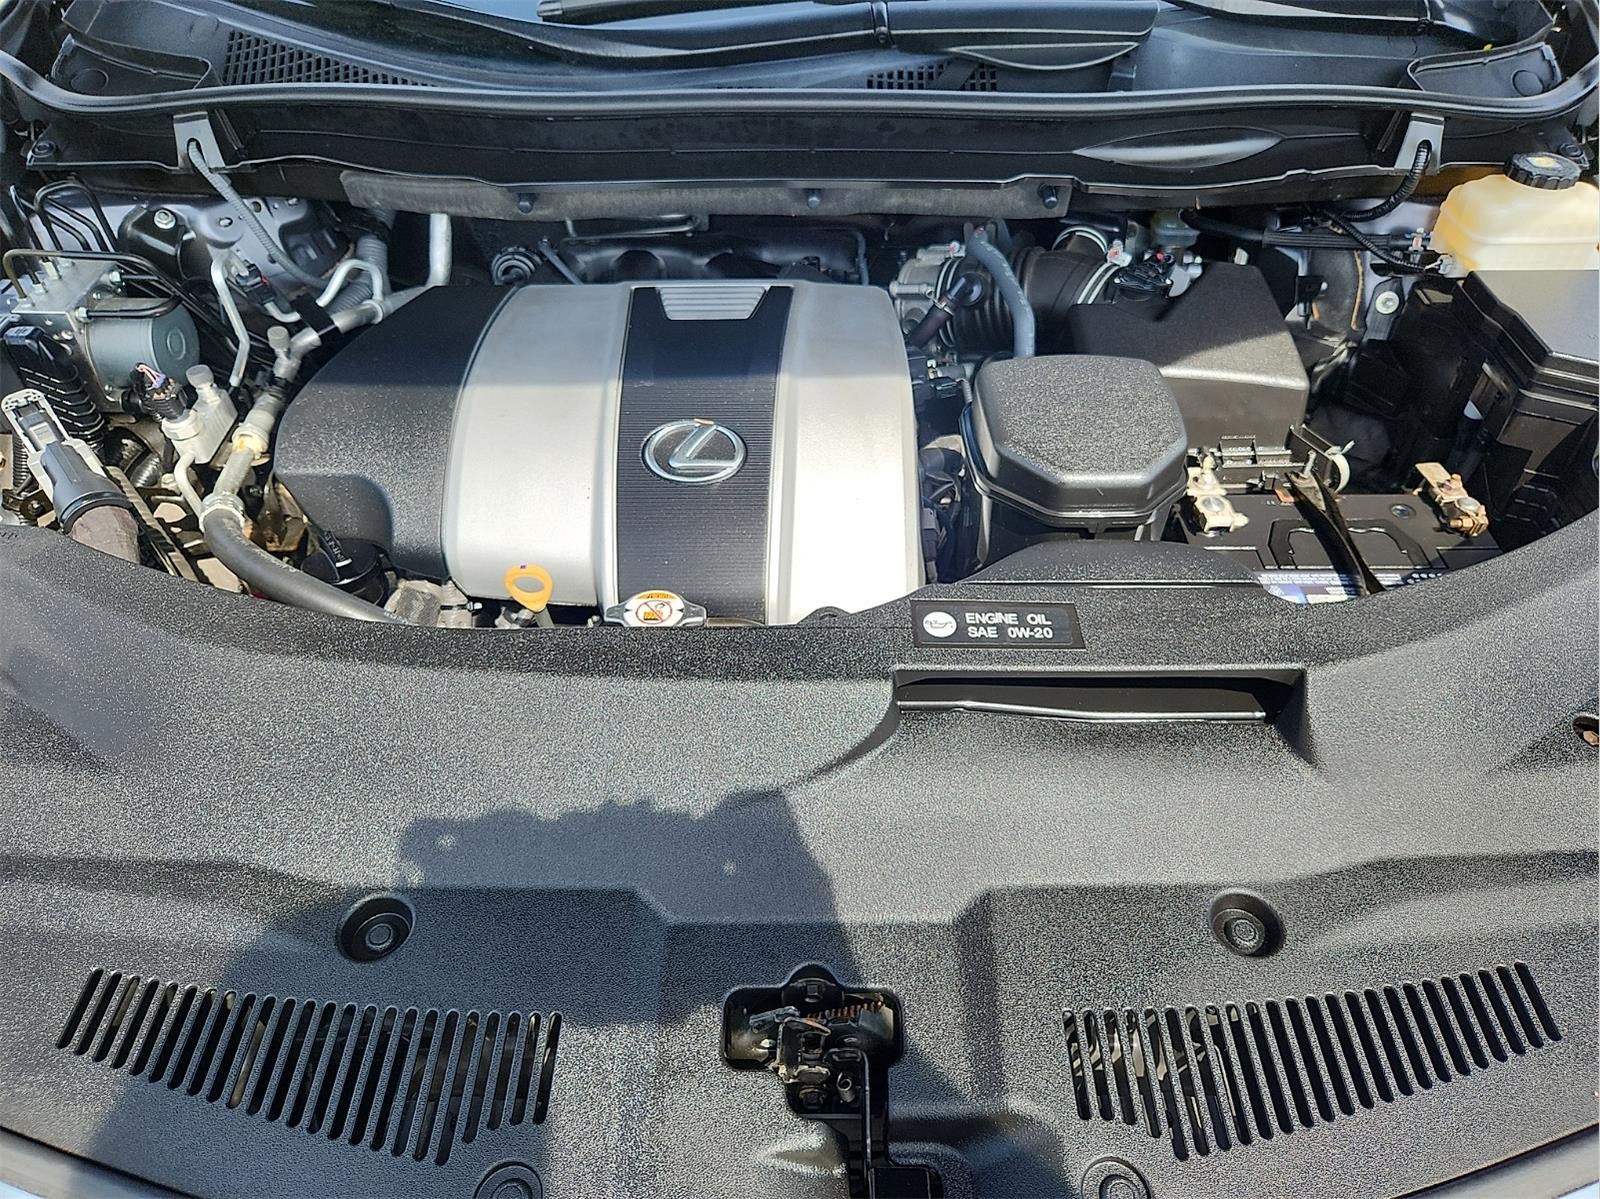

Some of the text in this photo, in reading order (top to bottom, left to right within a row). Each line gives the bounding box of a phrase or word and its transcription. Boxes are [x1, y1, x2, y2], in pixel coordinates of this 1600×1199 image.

[965, 612, 1052, 625] ENGINE OIL
[967, 626, 1053, 639] SAE 0W-20
